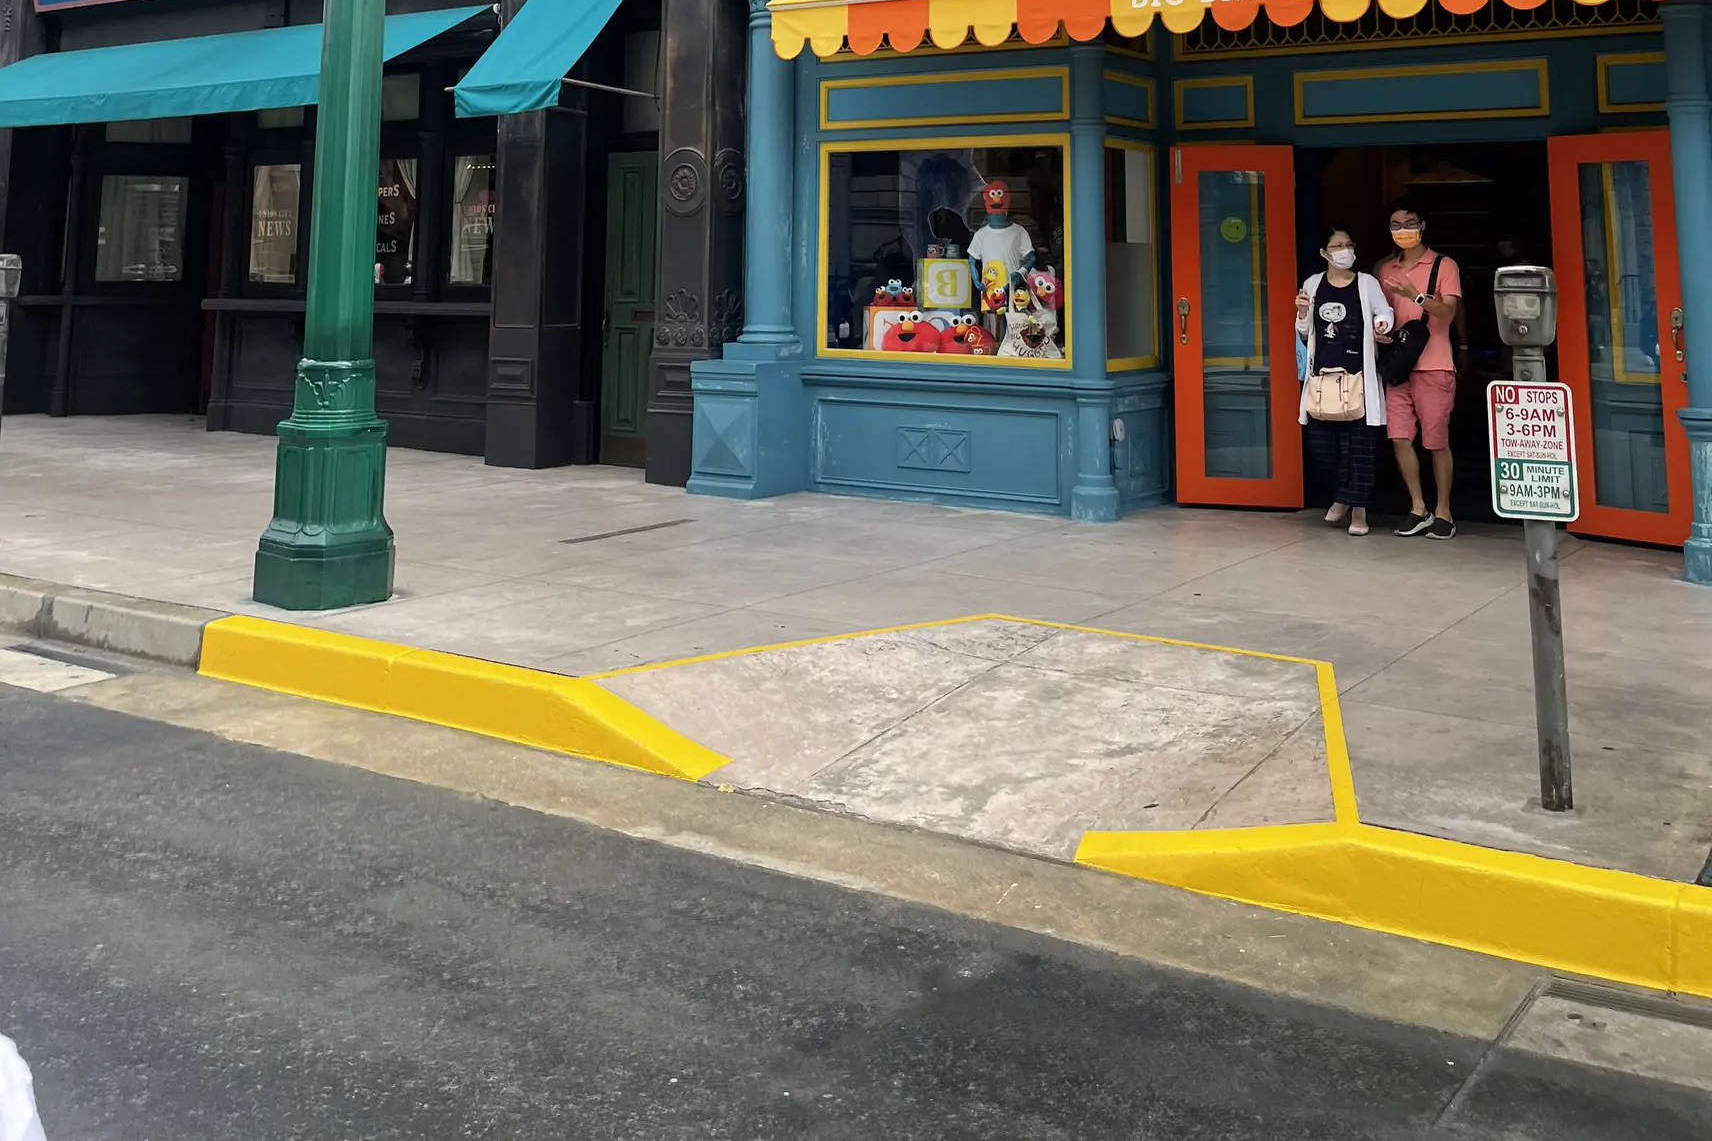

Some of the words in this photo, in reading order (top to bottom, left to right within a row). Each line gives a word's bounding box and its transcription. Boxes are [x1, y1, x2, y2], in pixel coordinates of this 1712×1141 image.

[257, 220, 292, 237] NEWS
[463, 216, 495, 235] NEW
[1495, 385, 1516, 404] NO
[1526, 390, 1558, 404] STOPS
[1505, 407, 1556, 422] 6-9AM
[1506, 423, 1557, 438] 3-6PM
[1501, 438, 1564, 450] TOW-AWAY-ZONE
[1507, 450, 1526, 458] EXCEPT
[1500, 462, 1520, 479] 30
[1526, 466, 1565, 475] MINUTE
[1531, 475, 1561, 484] LIMIT
[1510, 484, 1560, 500] 9AM-3PM
